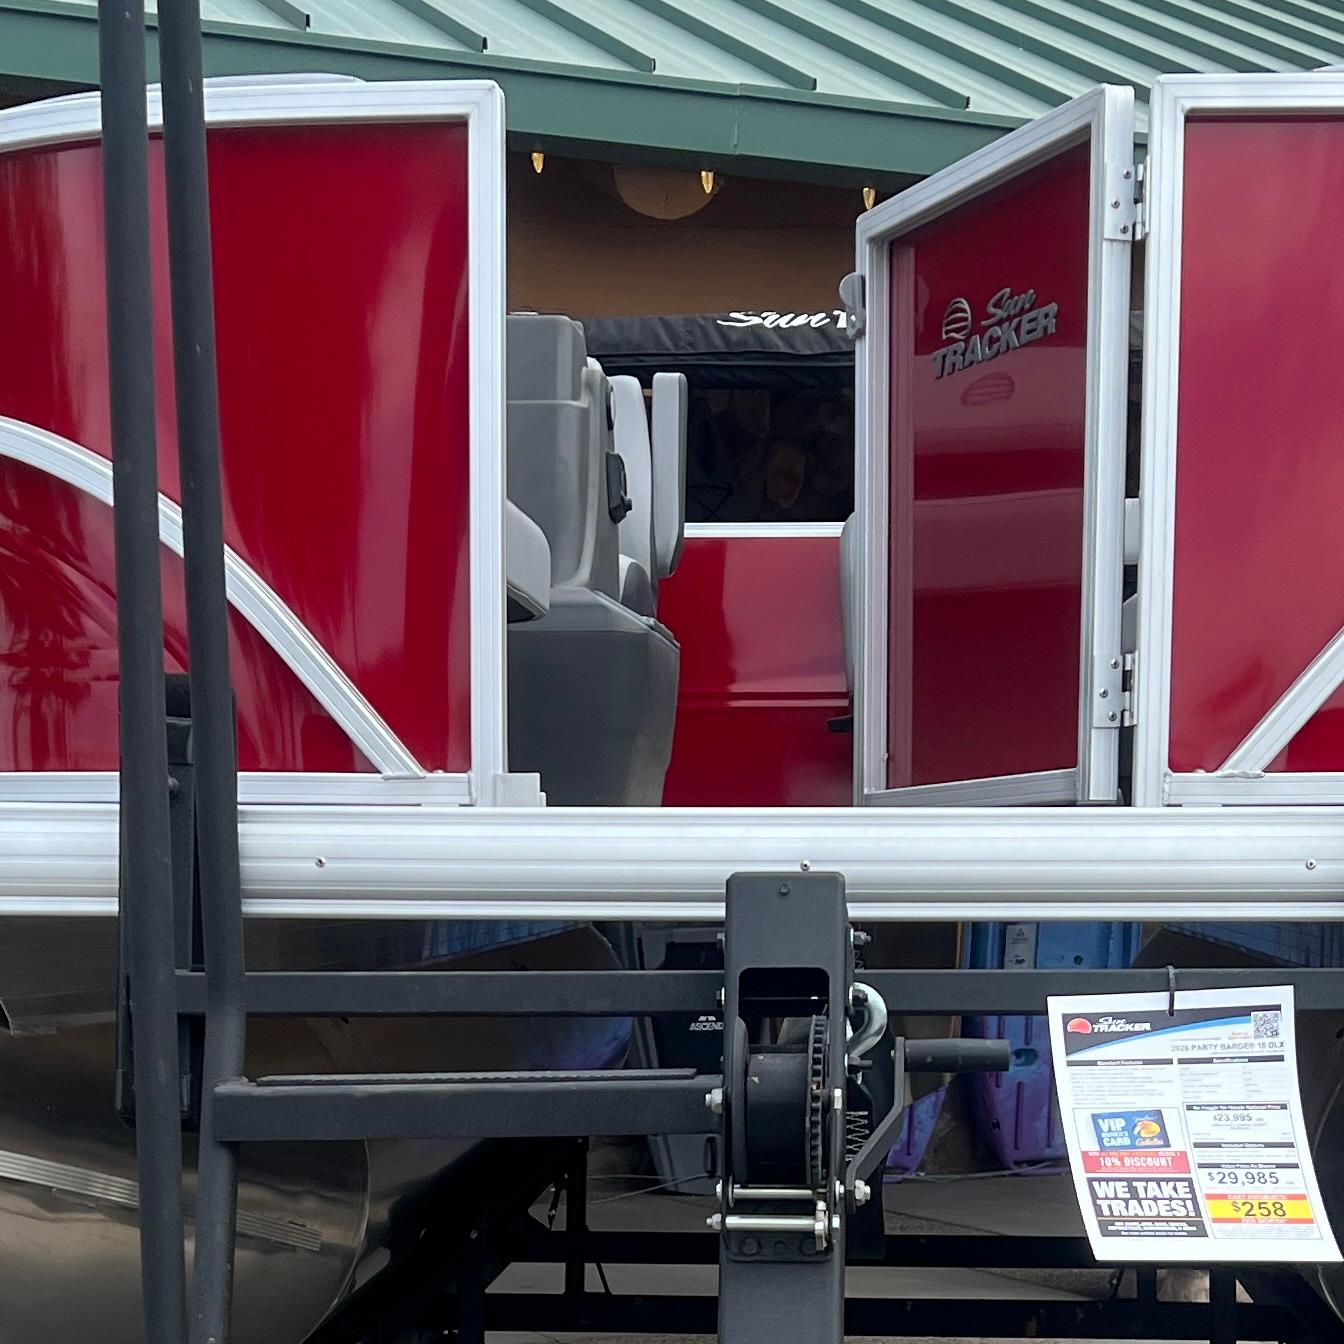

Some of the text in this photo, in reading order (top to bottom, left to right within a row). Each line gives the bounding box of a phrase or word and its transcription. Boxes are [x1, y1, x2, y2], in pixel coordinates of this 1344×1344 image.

[981, 287, 1036, 327] Sun
[716, 311, 830, 328] Sun
[931, 303, 1058, 379] TRACKER
[1092, 1022, 1152, 1032] TRACKER
[1191, 1043, 1219, 1052] PARTY
[1097, 1118, 1126, 1132] VIP
[1124, 1156, 1174, 1167] DISCOUNT
[1207, 1171, 1280, 1186] $29,985
[1092, 1181, 1193, 1199] WE TAKE
[1097, 1199, 1196, 1217] TRADES!
[1231, 1201, 1287, 1217] $258
